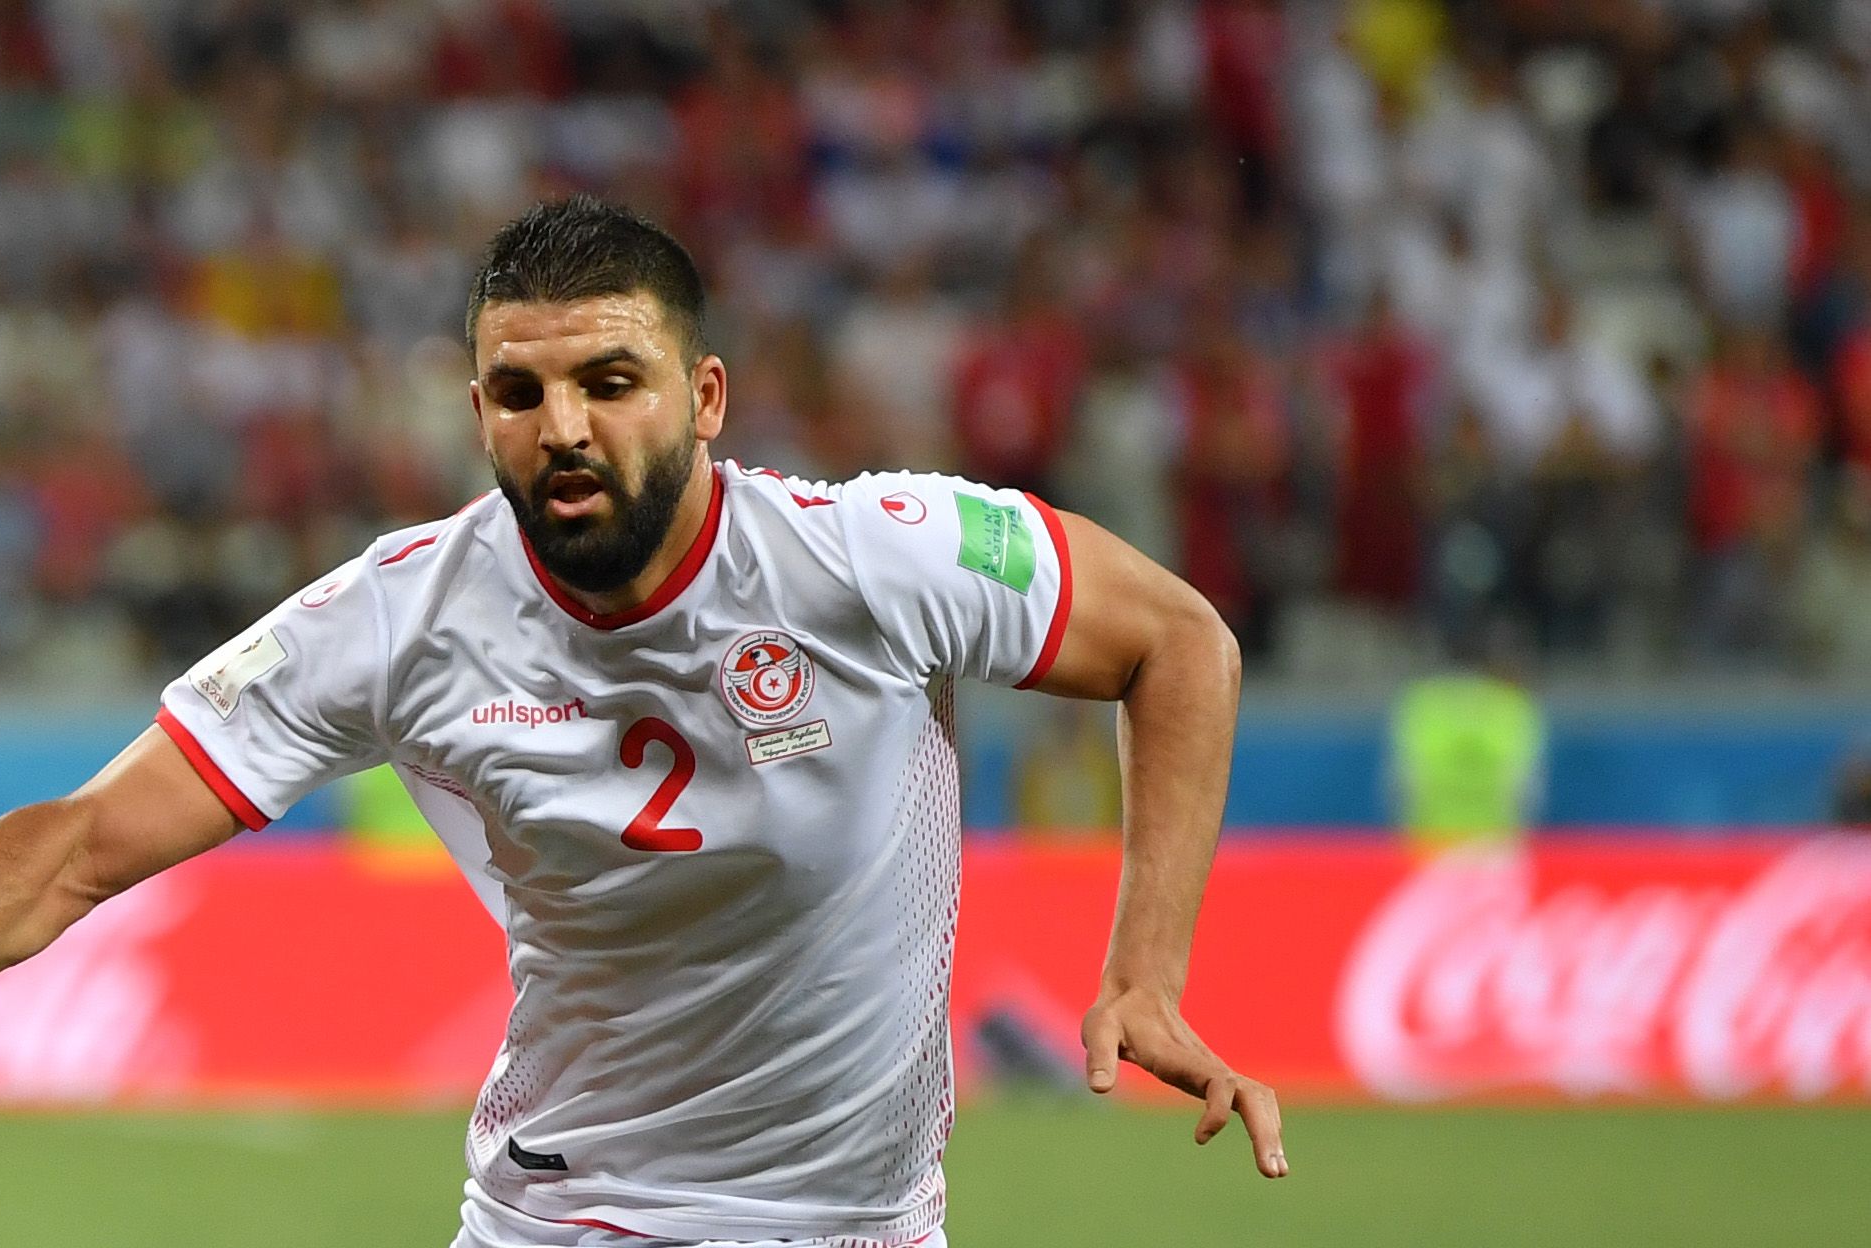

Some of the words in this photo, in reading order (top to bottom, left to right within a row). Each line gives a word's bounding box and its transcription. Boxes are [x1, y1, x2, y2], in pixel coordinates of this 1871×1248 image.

[981, 501, 992, 570] LIVING
[1009, 510, 1019, 536] FIFA
[472, 697, 589, 730] uhlsport
[618, 717, 704, 853] 2
